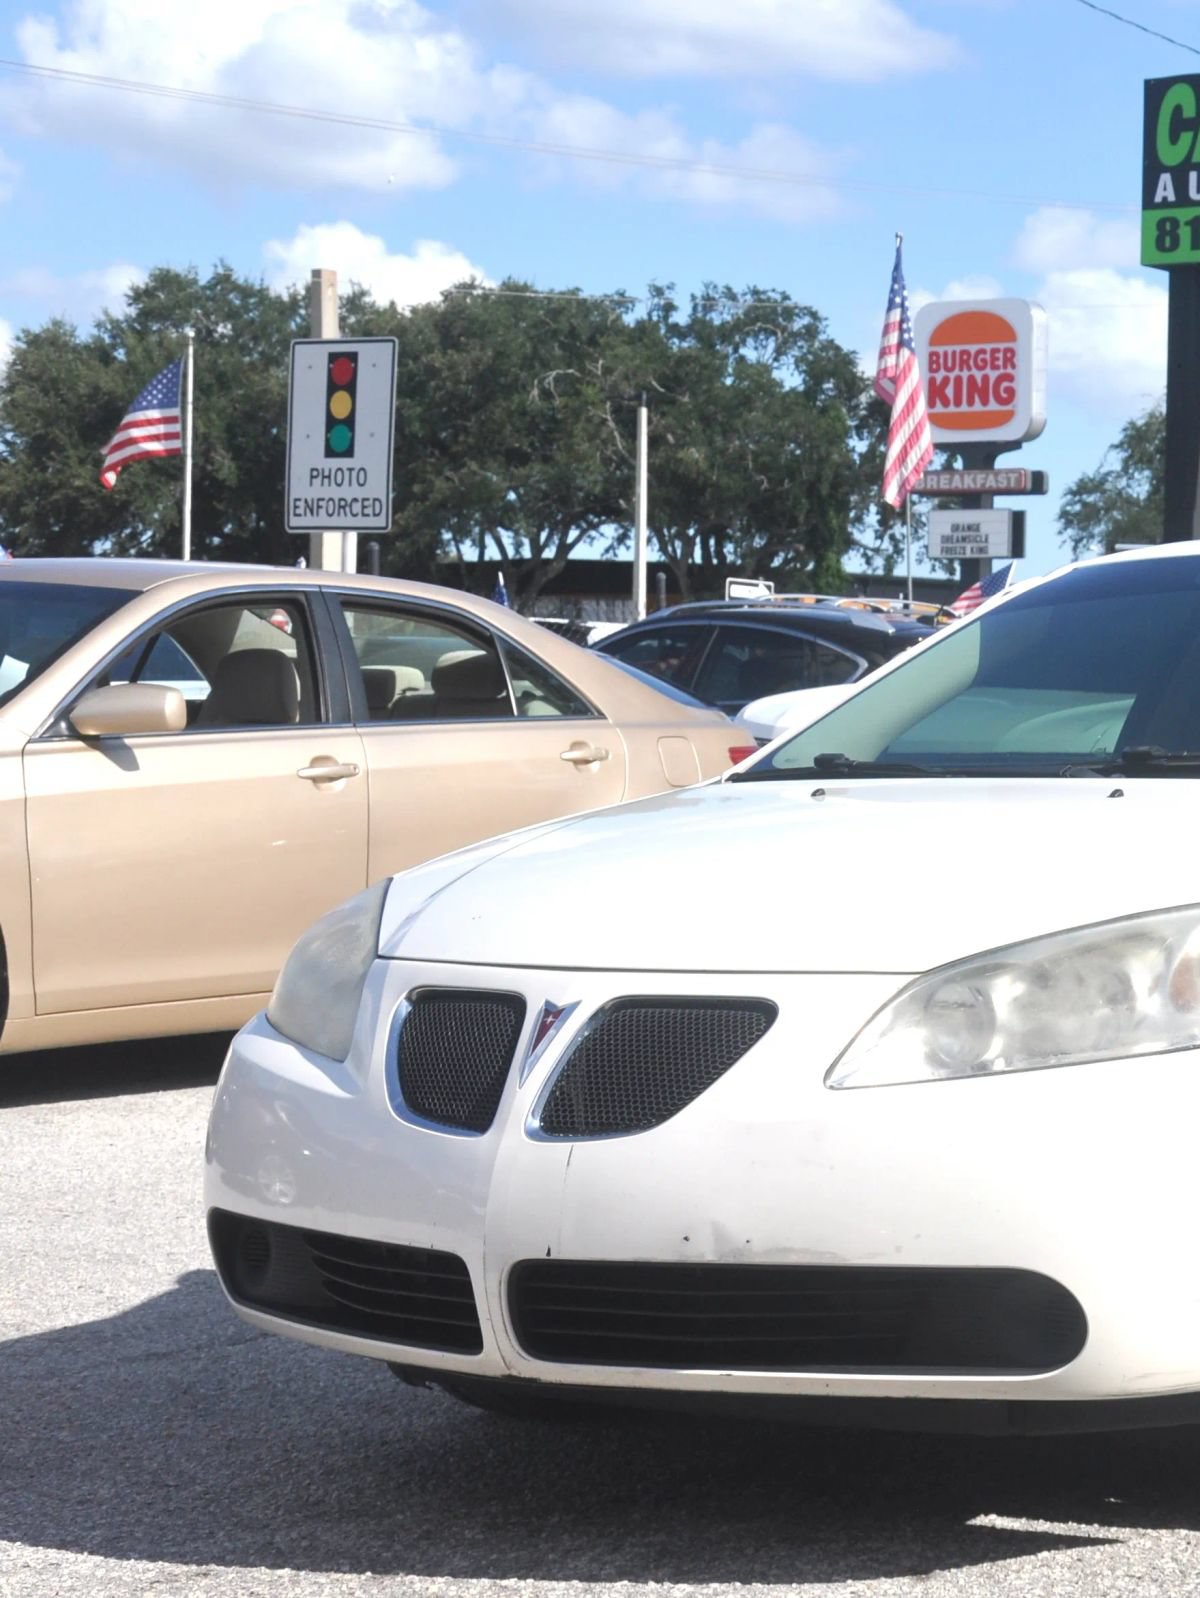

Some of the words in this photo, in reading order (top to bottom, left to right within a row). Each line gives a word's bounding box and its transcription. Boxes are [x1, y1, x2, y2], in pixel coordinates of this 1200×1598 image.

[928, 347, 1016, 374] BURGER
[927, 372, 1016, 409] KING
[309, 467, 367, 487] PHOTO
[293, 497, 383, 518] ENFORCED
[950, 523, 981, 533] ORANGE
[940, 546, 967, 556] FREEZE
[970, 545, 989, 555] KING
